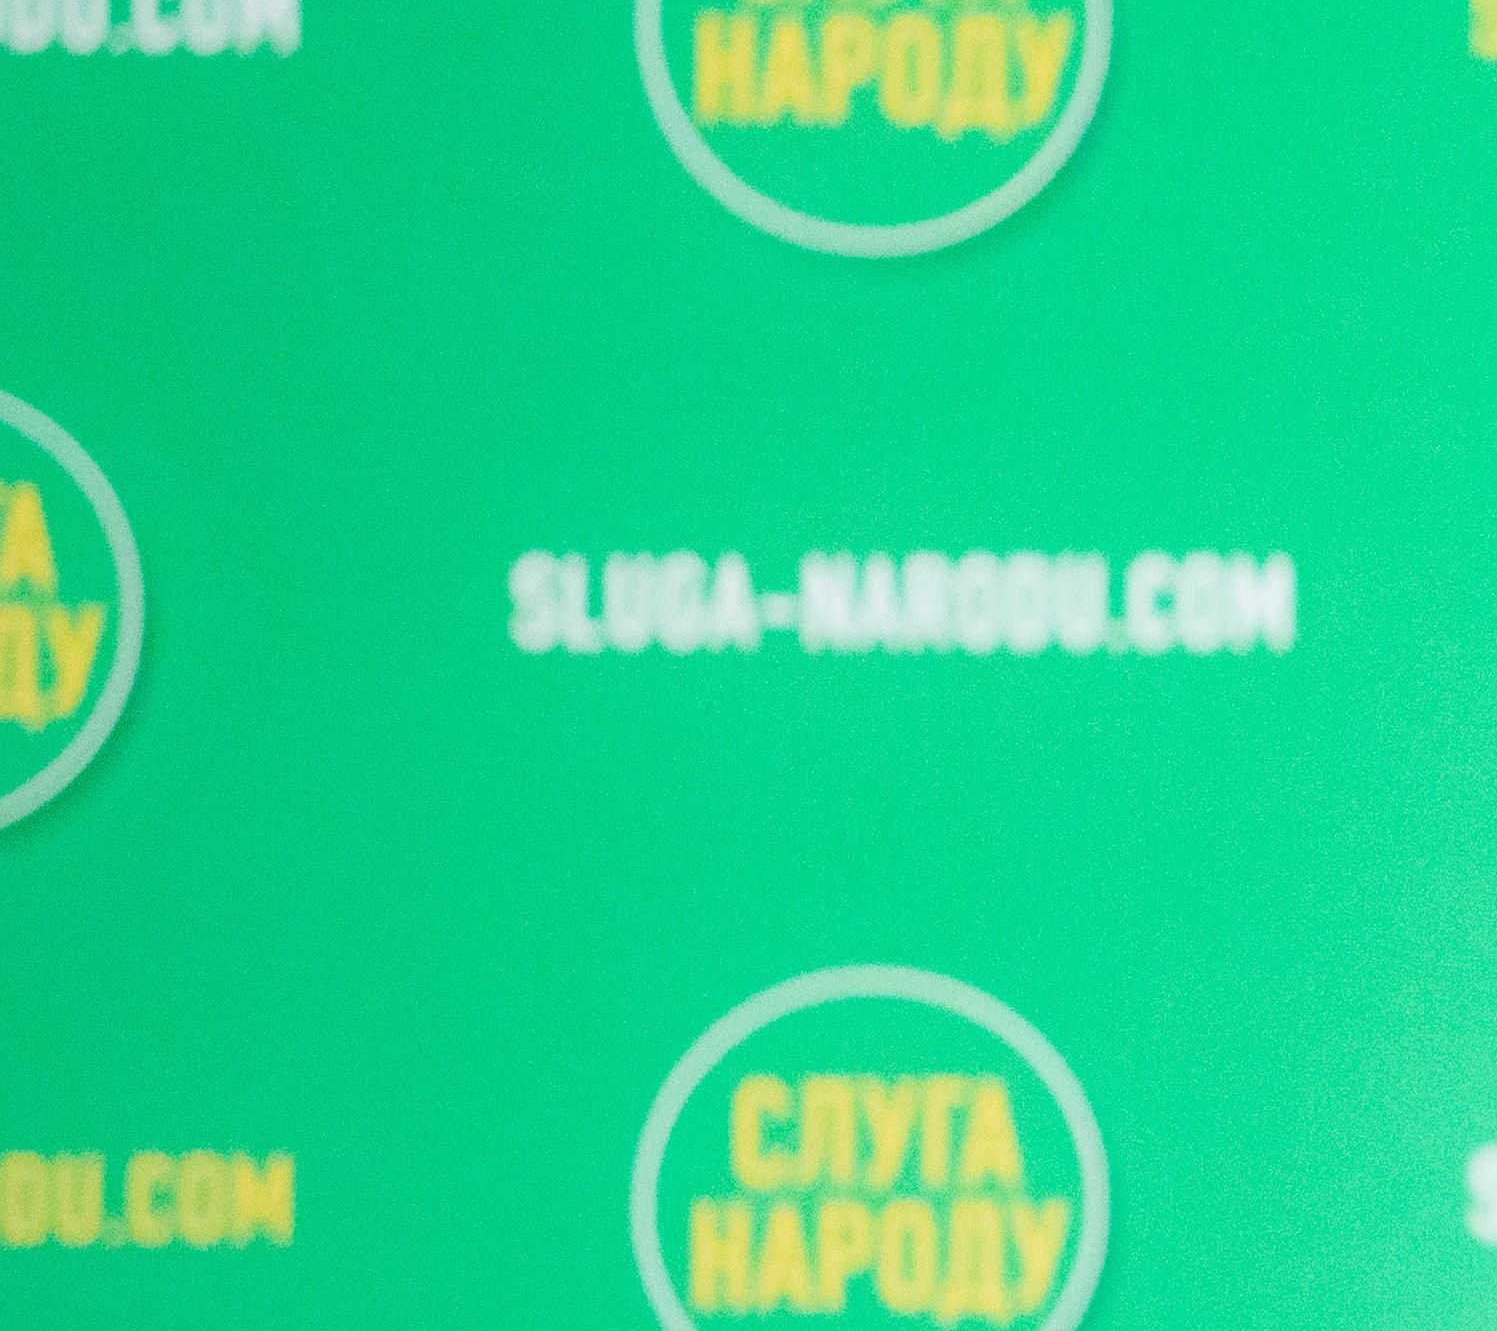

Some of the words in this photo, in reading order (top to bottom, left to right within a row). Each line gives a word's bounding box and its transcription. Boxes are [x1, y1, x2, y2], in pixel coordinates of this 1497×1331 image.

[694, 4, 1072, 136] НАРОДУ
[509, 551, 1297, 654] SLUGA-NARODU.COM
[731, 1074, 1023, 1191] СЛУГА
[689, 1192, 1069, 1324] НАРОДУ
